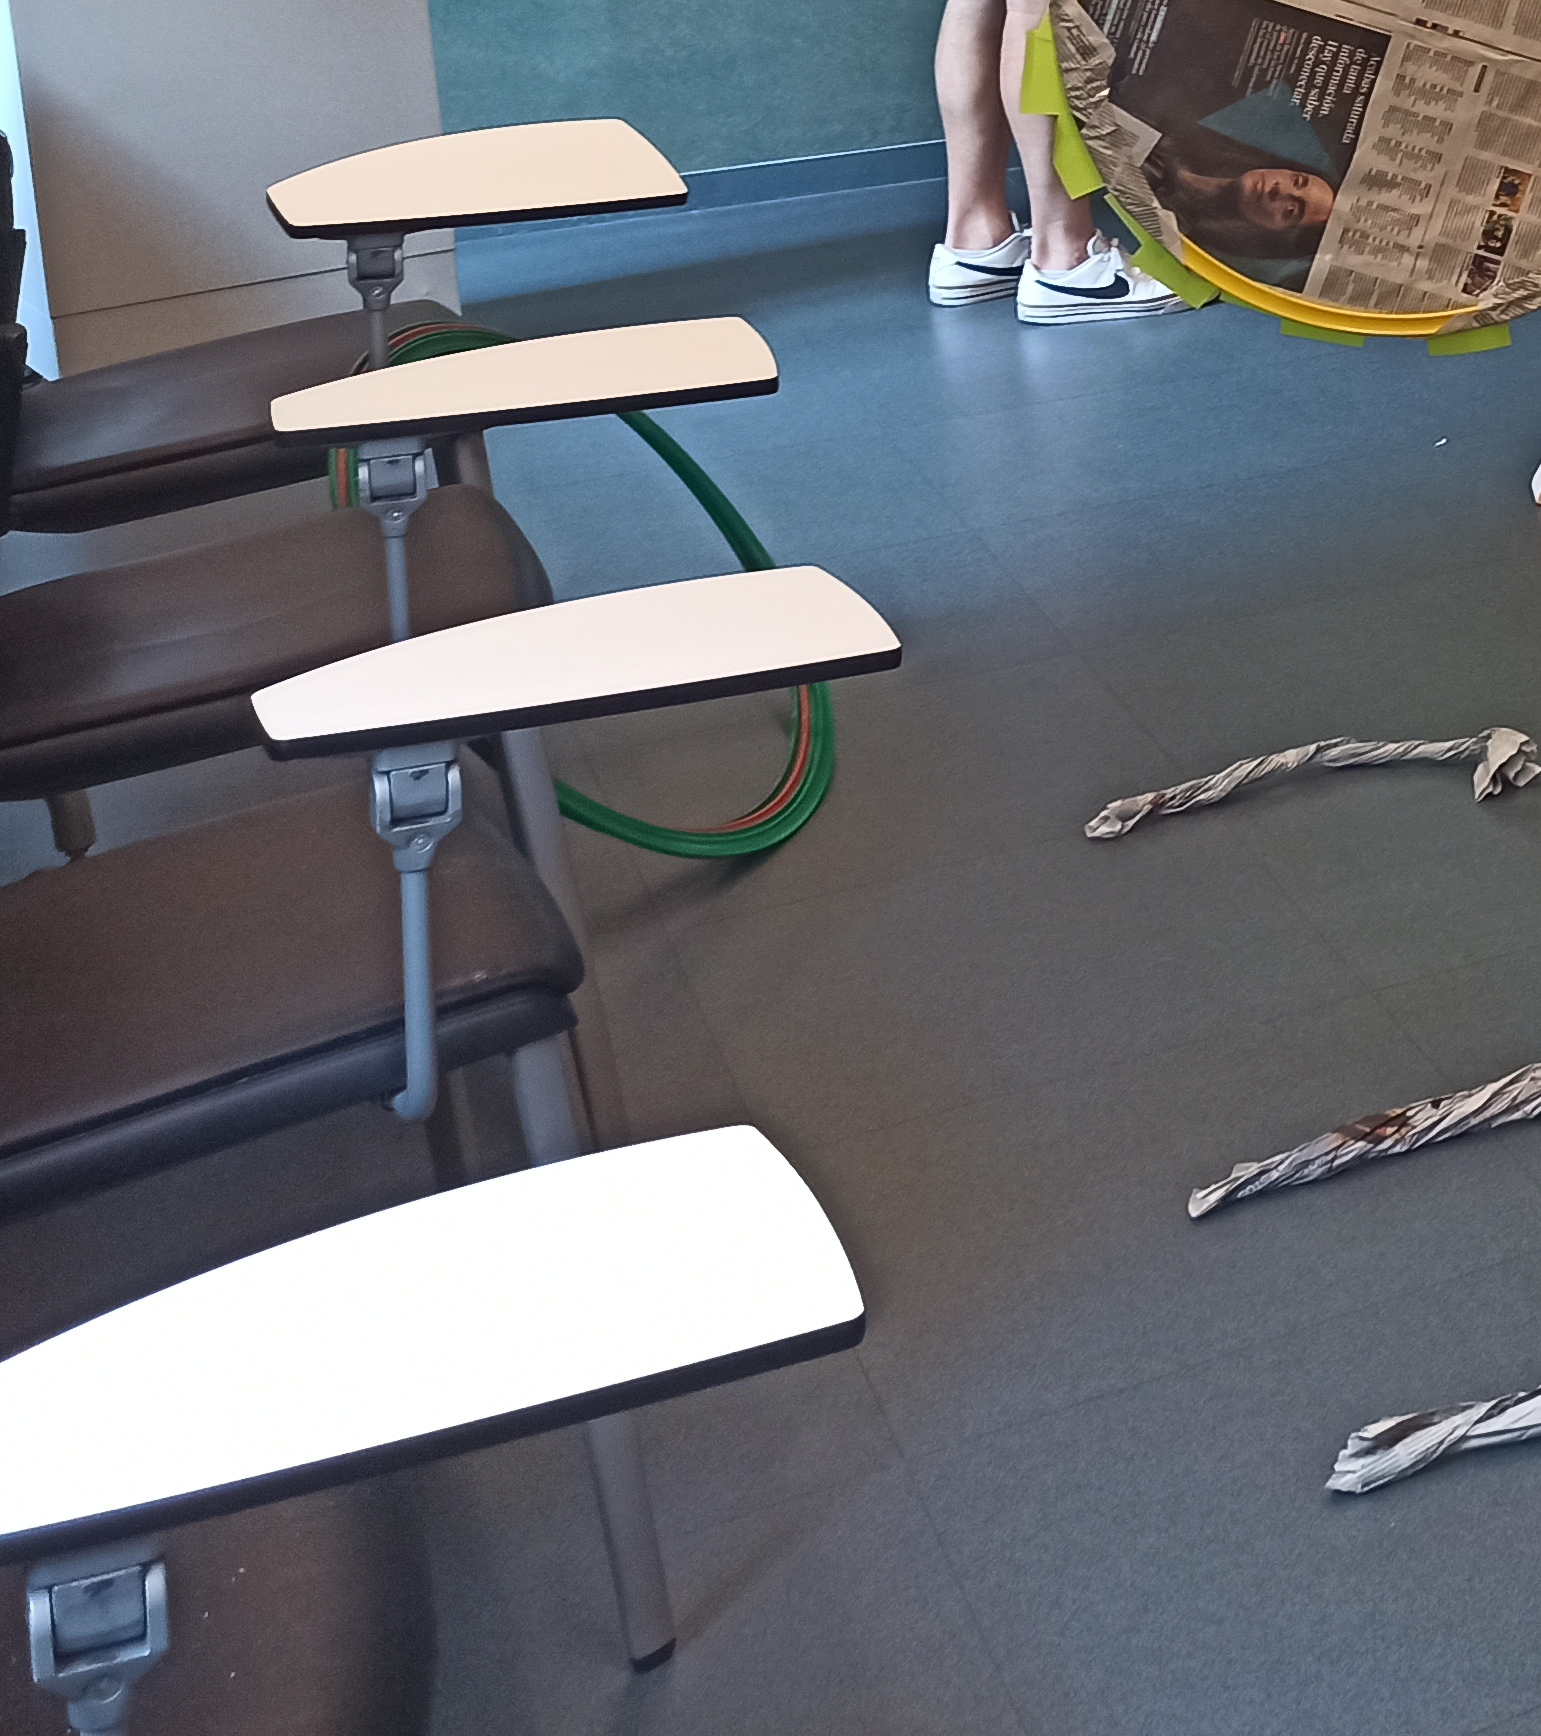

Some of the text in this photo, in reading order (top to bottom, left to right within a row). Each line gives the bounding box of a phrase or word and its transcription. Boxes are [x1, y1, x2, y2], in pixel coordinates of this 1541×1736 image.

[1288, 33, 1325, 109] desconectar.
[1300, 38, 1338, 122] Hay que saber
[1316, 41, 1355, 121] información.
[1340, 51, 1382, 146] Acabas saturada
[1341, 46, 1369, 96] de tanta
